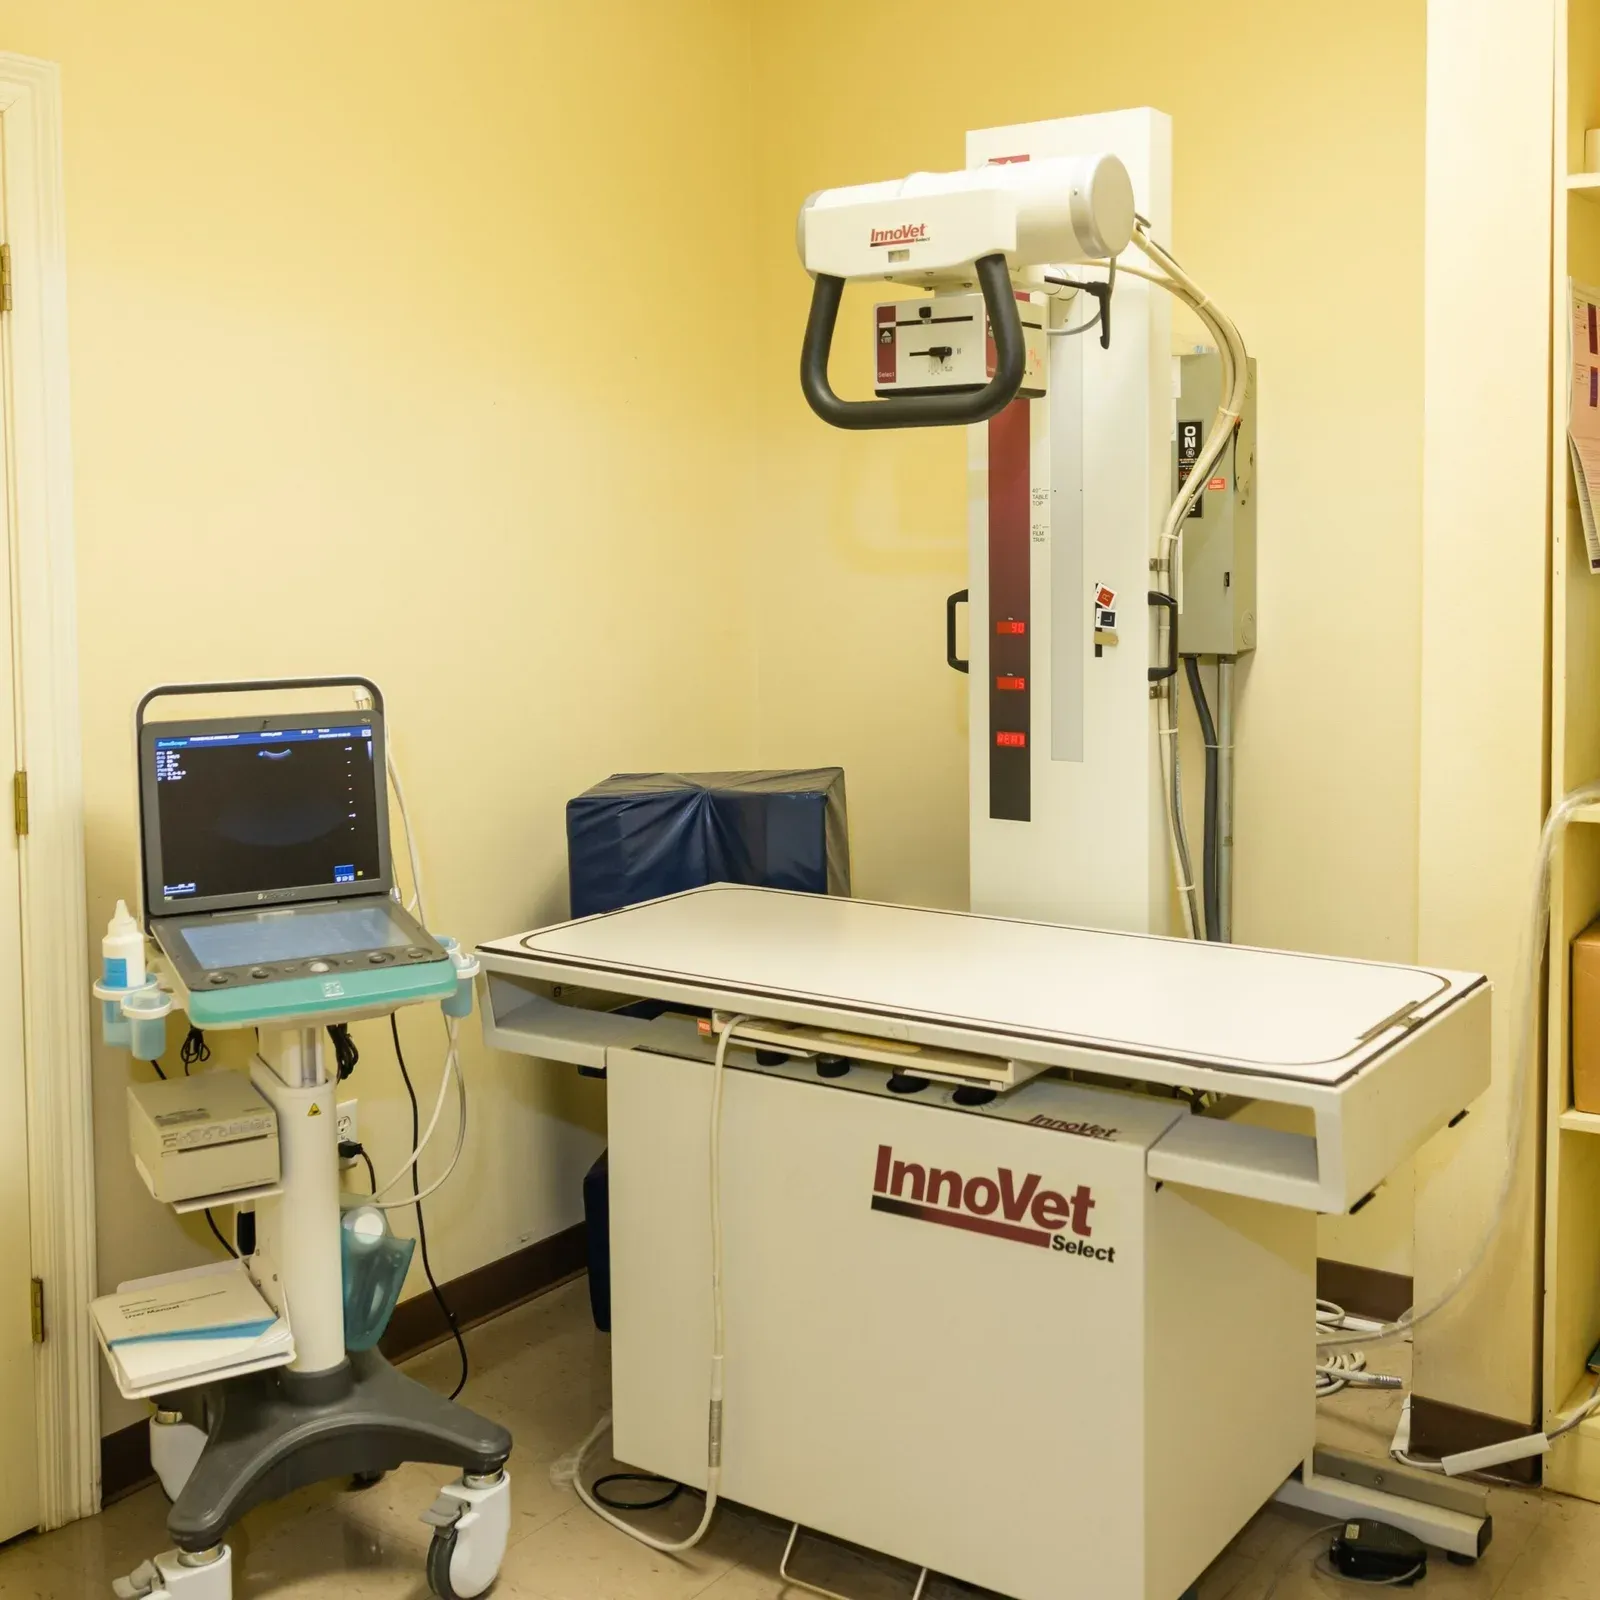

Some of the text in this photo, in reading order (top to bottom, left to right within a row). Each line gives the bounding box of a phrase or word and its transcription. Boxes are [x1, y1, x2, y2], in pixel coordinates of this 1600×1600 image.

[871, 223, 926, 242] InnoVet
[1184, 426, 1197, 448] ON
[1102, 593, 1111, 602] R
[1011, 622, 1025, 634] 90
[1029, 1114, 1117, 1138] InnoVet
[874, 1144, 1096, 1237] InnoVet
[1052, 1234, 1115, 1263] Select
